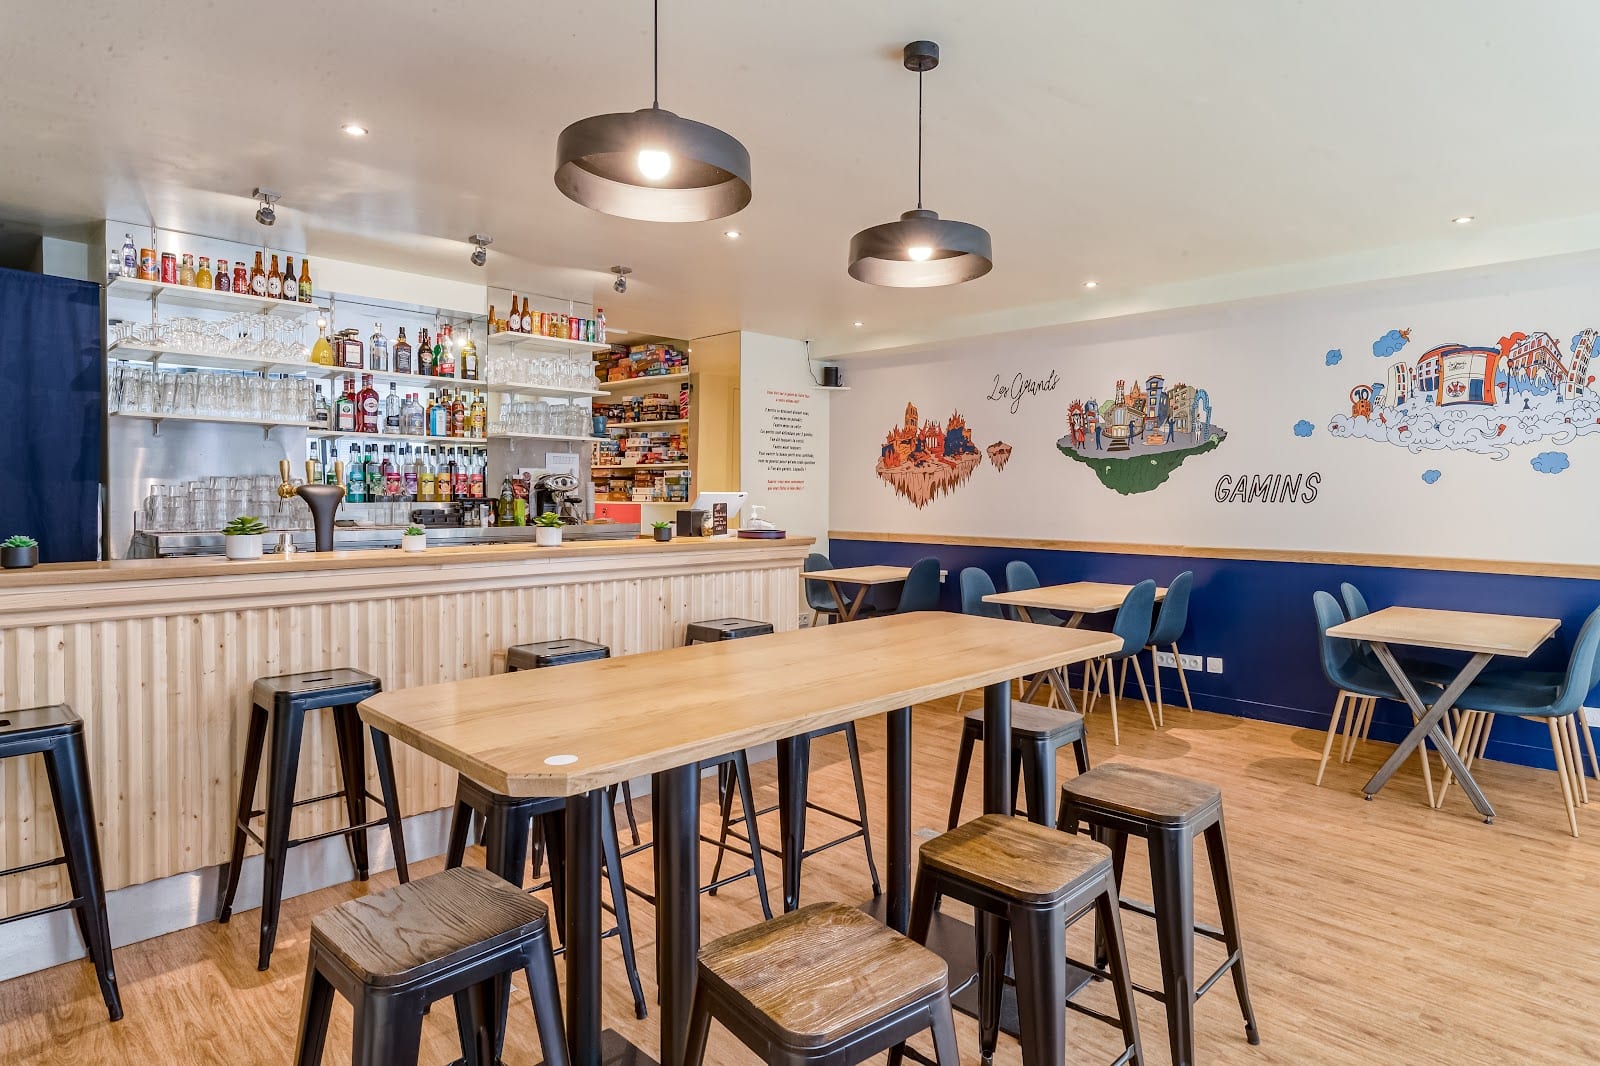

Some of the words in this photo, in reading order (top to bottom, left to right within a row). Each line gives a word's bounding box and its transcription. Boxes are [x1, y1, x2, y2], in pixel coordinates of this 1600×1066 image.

[986, 374, 1009, 400] Les
[1010, 369, 1060, 414] Grands
[1214, 471, 1321, 503] GAMINS
